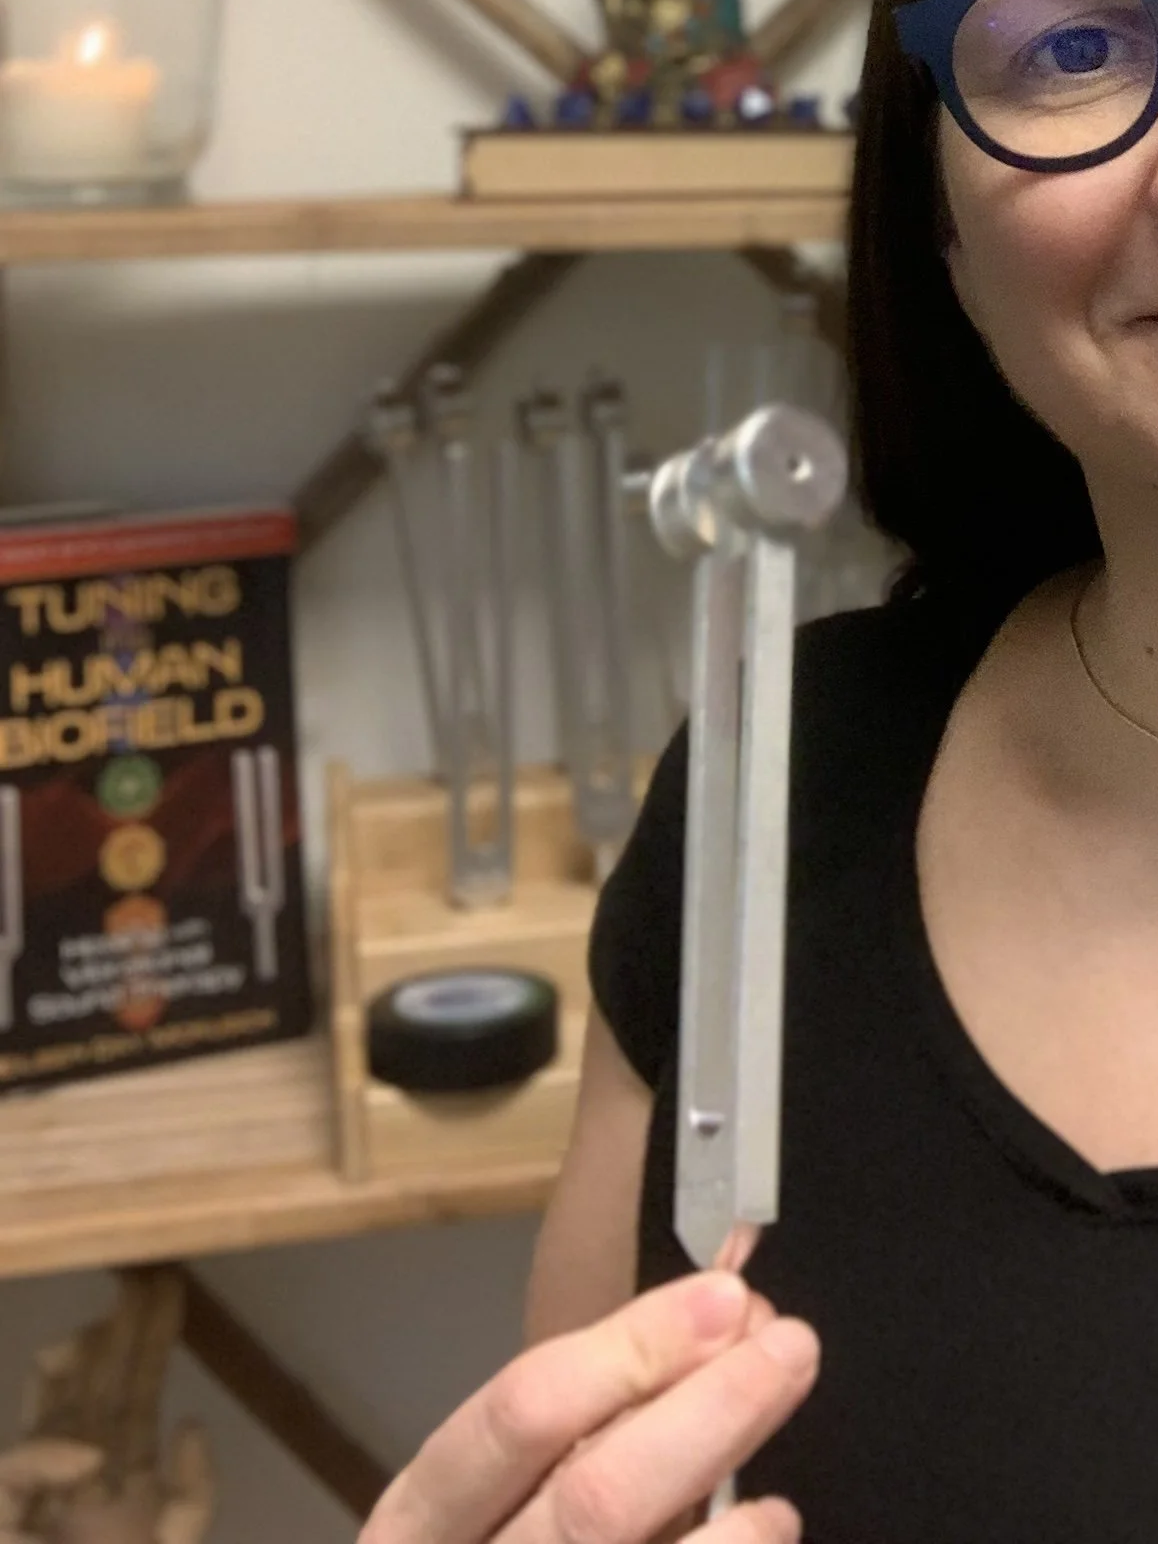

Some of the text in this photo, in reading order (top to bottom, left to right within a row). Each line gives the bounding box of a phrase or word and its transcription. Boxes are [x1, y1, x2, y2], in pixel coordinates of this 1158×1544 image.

[7, 566, 241, 634] TUNING
[11, 639, 242, 712] HUMAN
[0, 687, 264, 769] BIOFIELD
